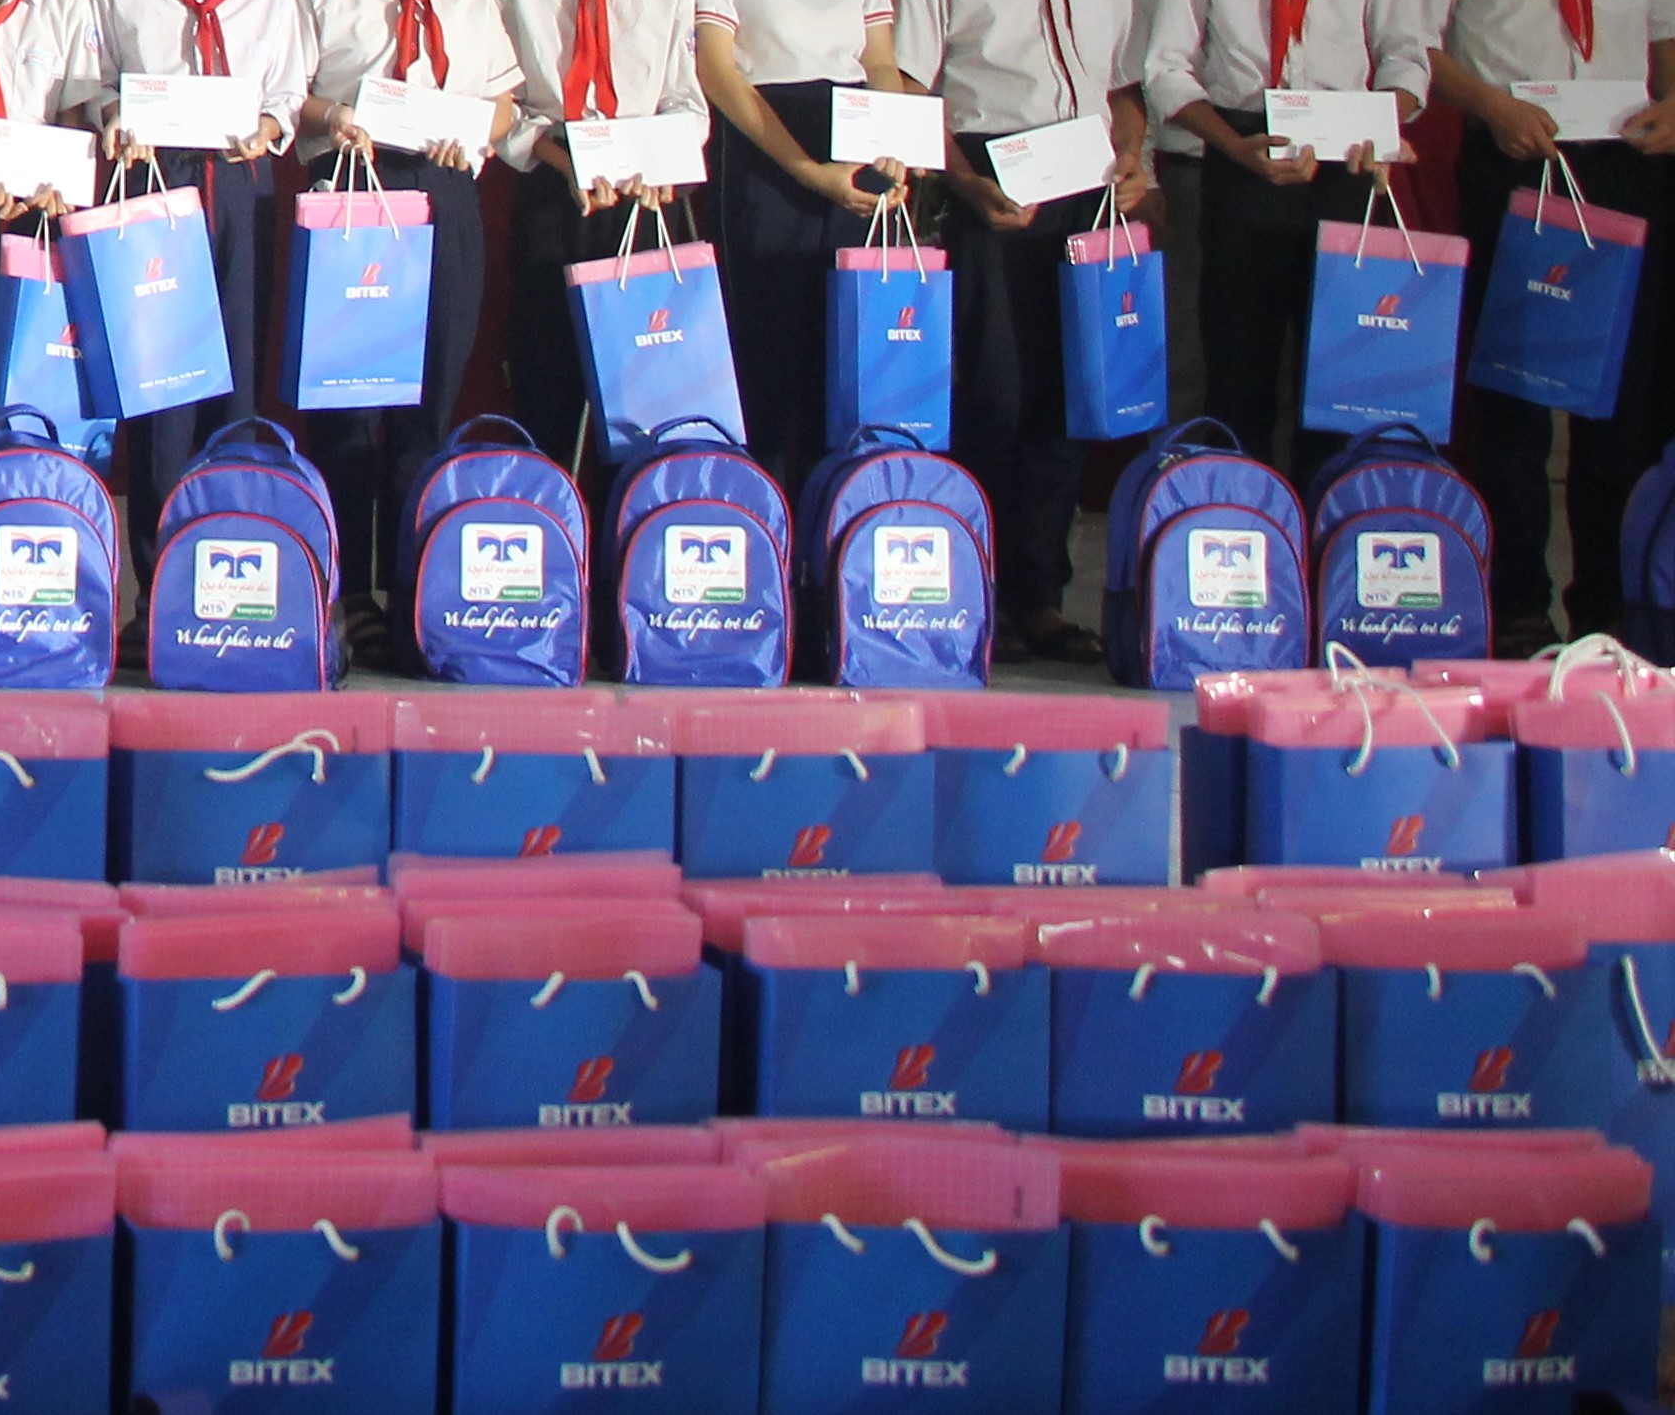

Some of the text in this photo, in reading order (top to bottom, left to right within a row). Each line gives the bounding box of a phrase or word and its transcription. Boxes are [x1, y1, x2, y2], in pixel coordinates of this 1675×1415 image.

[134, 278, 178, 298] BITEX
[346, 286, 390, 298] BITEX
[1116, 313, 1139, 327] BITEX
[1358, 315, 1408, 330] BITEX
[636, 330, 684, 347] BITEX
[888, 329, 921, 341] BITEX
[1015, 865, 1097, 884] BITEX
[861, 1092, 954, 1118] BITEX
[1438, 1093, 1531, 1118] BITEX
[229, 1103, 324, 1127] BITEX
[230, 1360, 332, 1384] BITEX
[1165, 1356, 1267, 1382] BITEX
